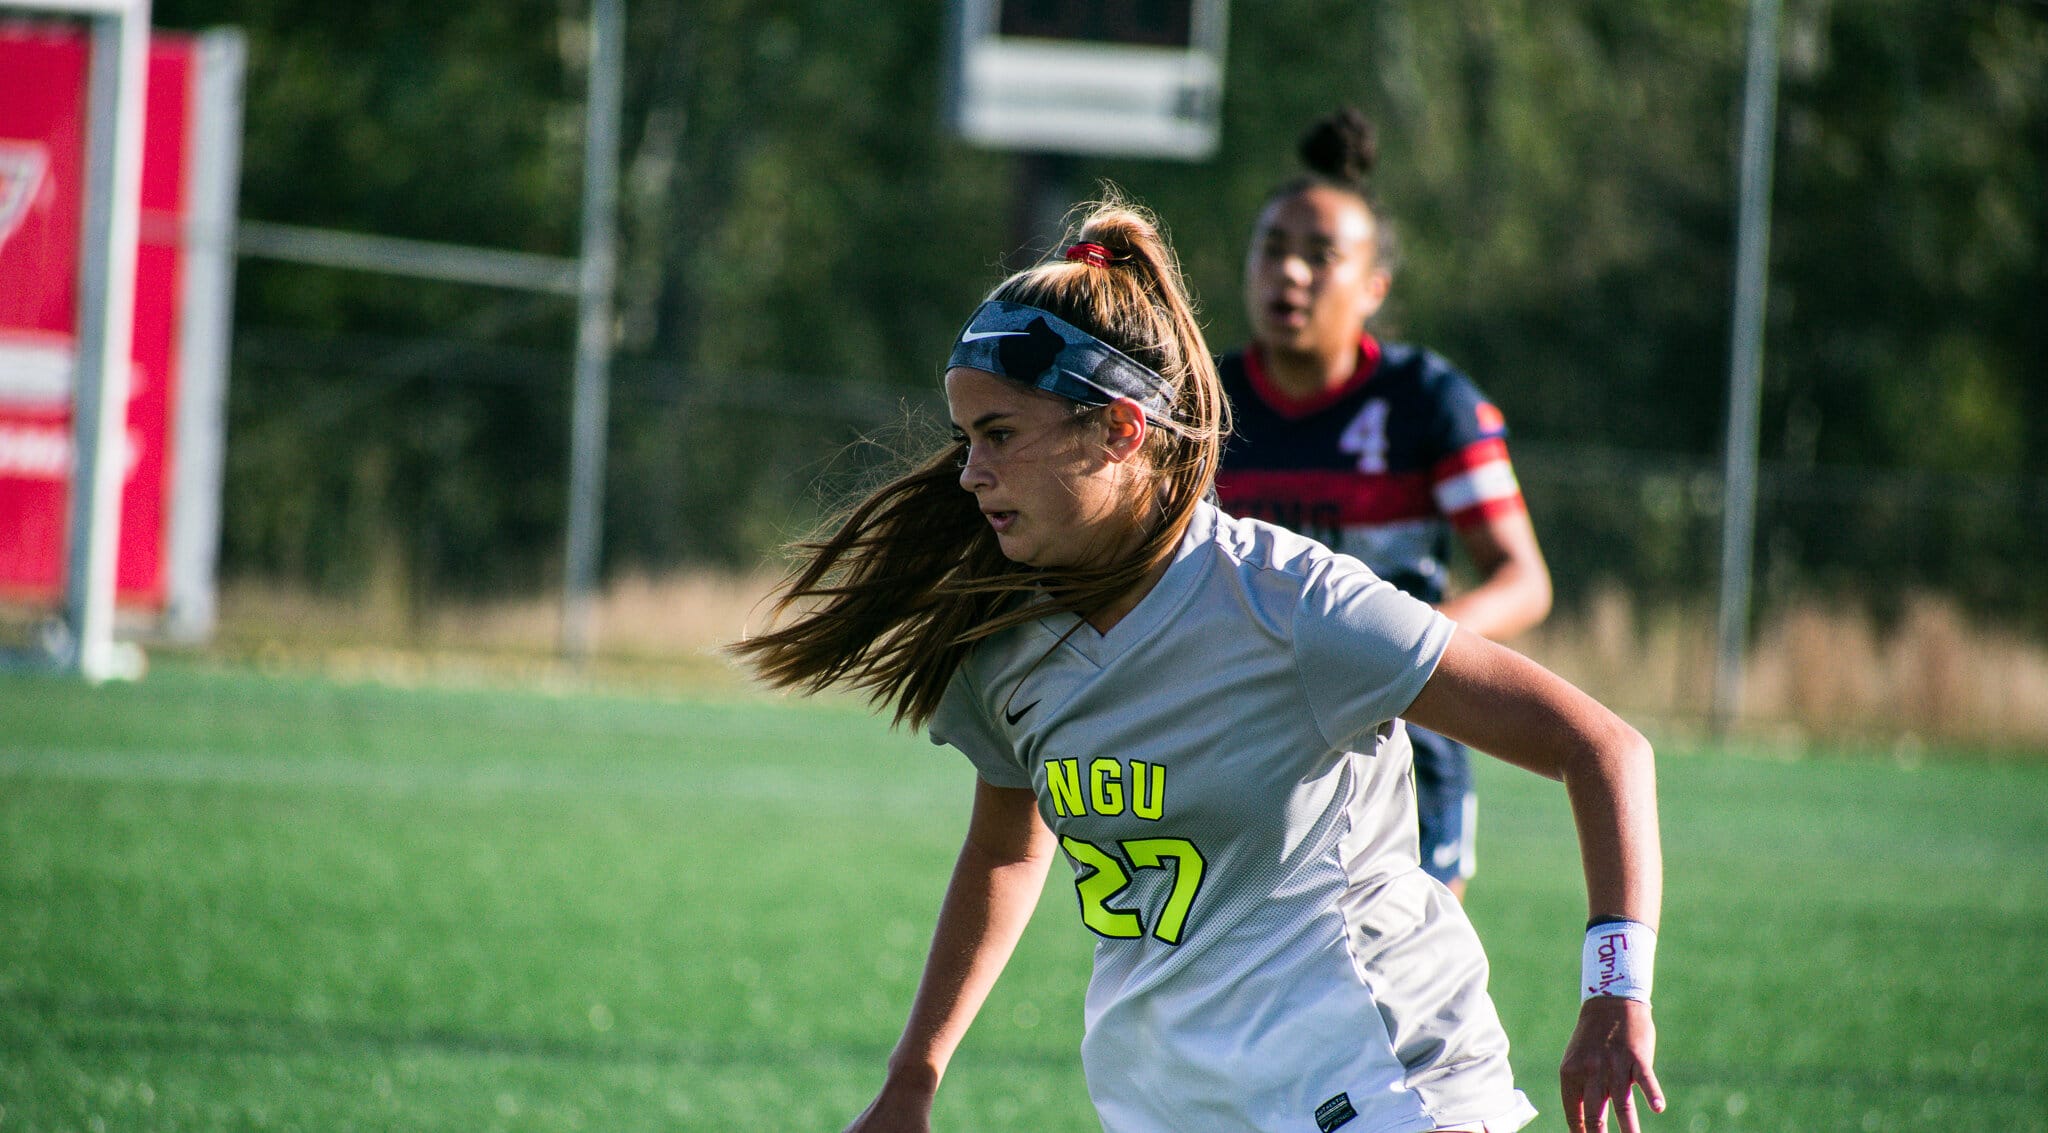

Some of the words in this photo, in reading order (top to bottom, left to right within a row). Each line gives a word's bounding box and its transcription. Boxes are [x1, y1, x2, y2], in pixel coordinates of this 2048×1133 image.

[1338, 397, 1388, 473] 4
[1044, 757, 1167, 820] NGU
[1059, 834, 1208, 946] 27
[1588, 934, 1627, 996] Family
